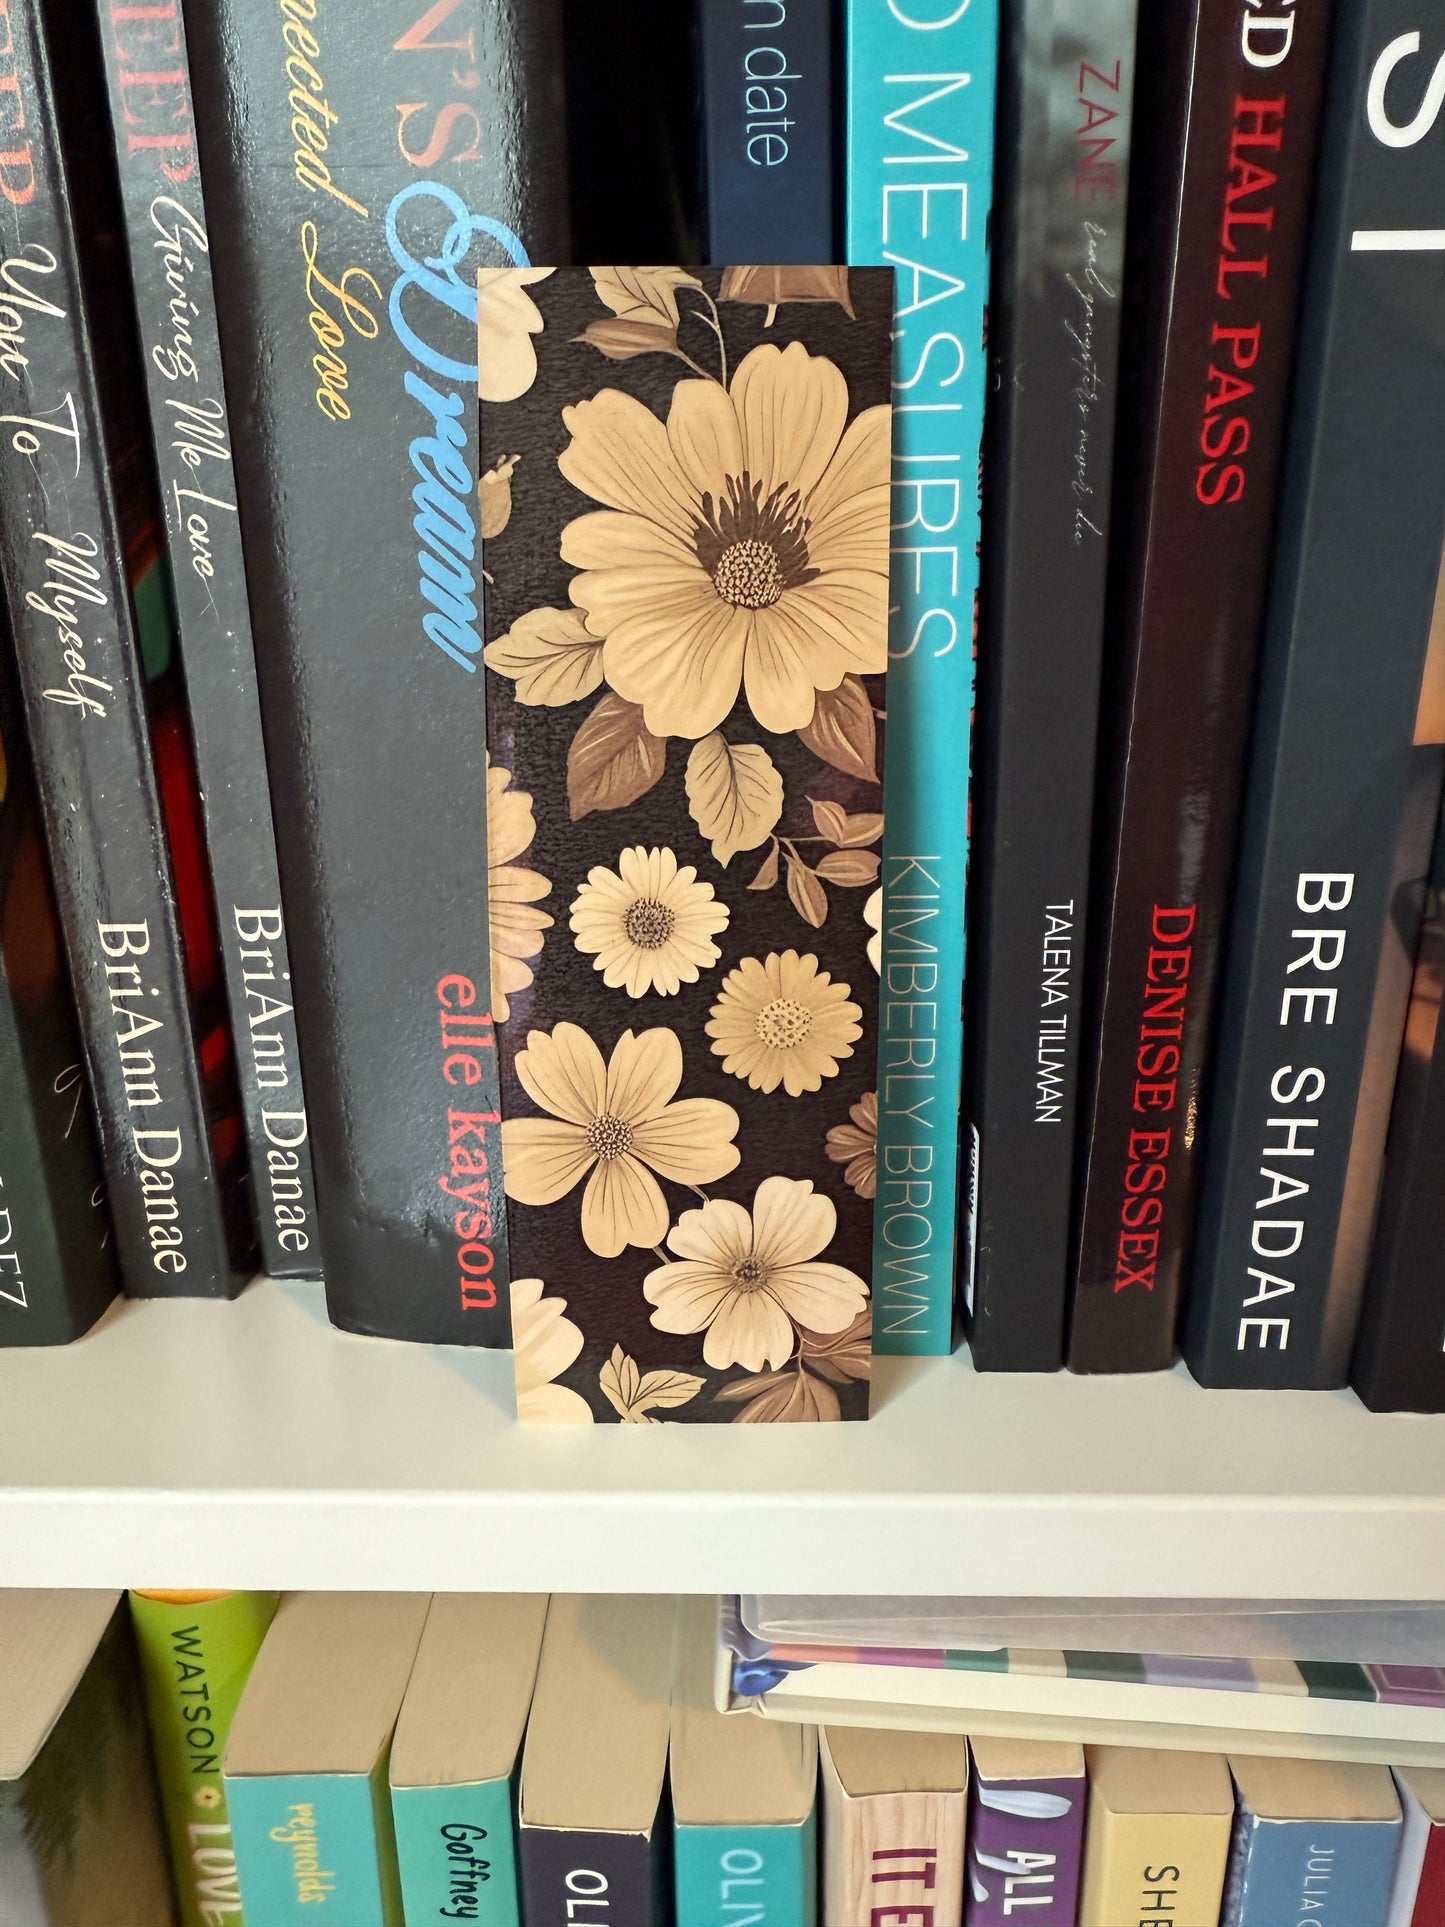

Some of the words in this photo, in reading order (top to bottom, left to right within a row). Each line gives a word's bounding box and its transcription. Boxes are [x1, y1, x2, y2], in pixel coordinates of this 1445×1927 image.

[744, 46, 803, 166] date
[1072, 59, 1121, 200] ZANE
[1216, 93, 1288, 301] HALL
[150, 195, 209, 384] Giving
[301, 220, 383, 421] Love
[881, 72, 971, 659] MEASURES
[0, 391, 80, 482] To
[164, 397, 231, 476] Me
[385, 180, 531, 673] Dream
[1195, 320, 1263, 506] PASS
[173, 479, 237, 598] Love
[26, 531, 108, 720] Myself
[233, 903, 294, 1090] BriAnn
[884, 854, 941, 1129] KIMBERLY
[1040, 899, 1074, 1008] TALENA
[1132, 903, 1198, 1113] DENISE
[1279, 872, 1355, 1026] BRE
[96, 918, 164, 1108] BriAnn
[132, 1125, 187, 1274] Danae
[437, 973, 496, 1087] elle
[1033, 1013, 1068, 1123] TILLMAN
[261, 1109, 310, 1252] Danae
[438, 1107, 502, 1312] kayson
[882, 1144, 934, 1336] BROWN
[1113, 1128, 1172, 1294] ESSEX
[1236, 1065, 1327, 1352] SHADAE
[170, 1625, 220, 1776] WATSON
[269, 1802, 336, 1904] reynolds
[439, 1823, 491, 1919] Goffney
[871, 1848, 938, 1889] IT
[1003, 1850, 1057, 1916] ALL
[1300, 1844, 1336, 1911] JULIA
